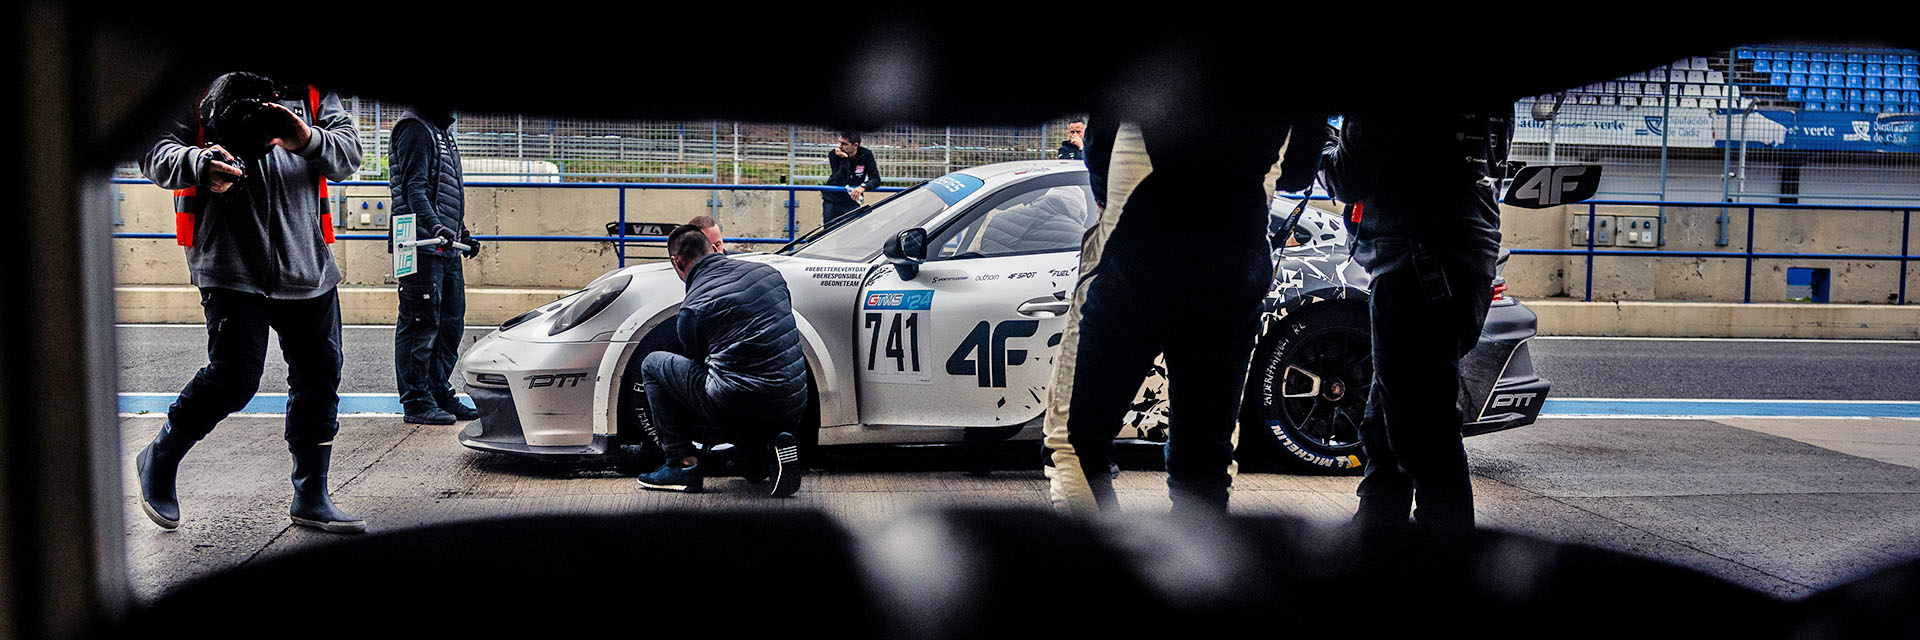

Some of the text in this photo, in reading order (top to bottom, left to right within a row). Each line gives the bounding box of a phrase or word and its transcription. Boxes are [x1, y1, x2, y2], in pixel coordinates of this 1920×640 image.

[1593, 119, 1625, 130] verte
[1803, 125, 1835, 137] verte
[1515, 167, 1587, 205] 4F
[1017, 271, 1037, 280] SPOT
[868, 293, 904, 307] GTWS
[865, 313, 920, 372] 741
[946, 320, 1039, 388] 4F
[527, 373, 588, 389] PTT
[1491, 392, 1538, 409] PTT
[1270, 424, 1335, 468] MICHELIN
